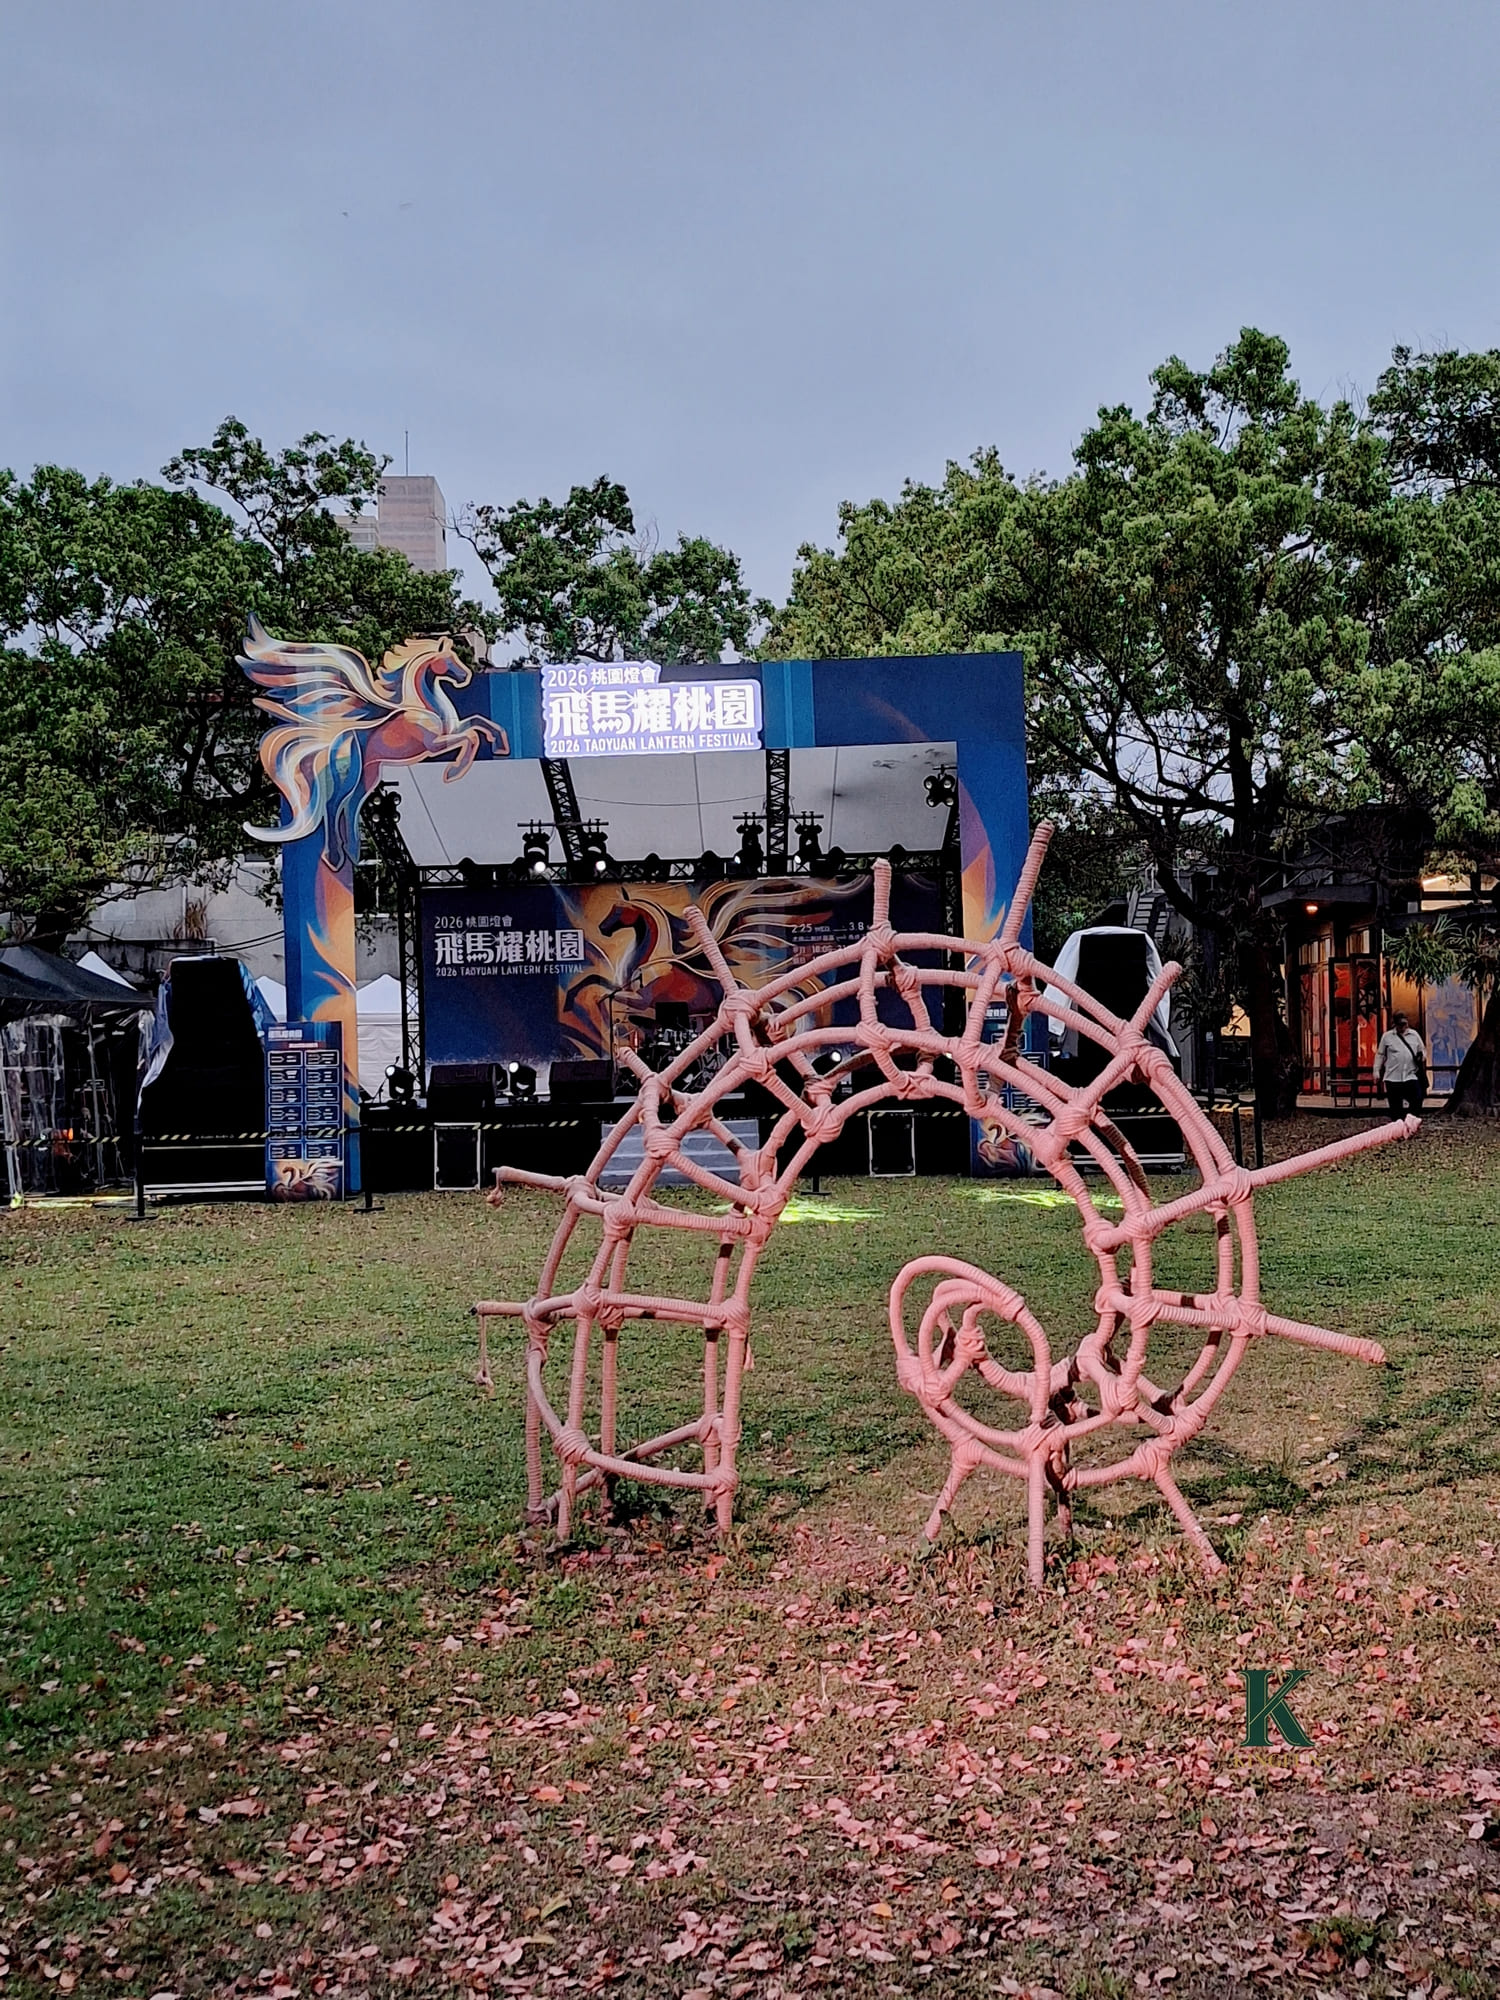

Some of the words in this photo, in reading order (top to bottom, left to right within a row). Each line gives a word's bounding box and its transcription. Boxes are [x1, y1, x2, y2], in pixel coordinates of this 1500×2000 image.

[548, 668, 588, 687] 2026
[591, 666, 657, 685] 桃園燈會
[549, 685, 755, 738] 飛馬耀桃園
[550, 739, 580, 753] 2026
[584, 737, 636, 752] TAOYUAN
[640, 735, 695, 750] LANTERN
[699, 732, 754, 748] FESTIVAL
[434, 916, 463, 929] 2026
[466, 915, 513, 928] 桃園燈會
[434, 929, 585, 966] 飛馬耀桃園
[436, 967, 457, 977] 2026
[460, 966, 498, 976] TAOYUAN
[501, 965, 541, 976] LANTERN
[543, 963, 584, 974] FESTIVAL
